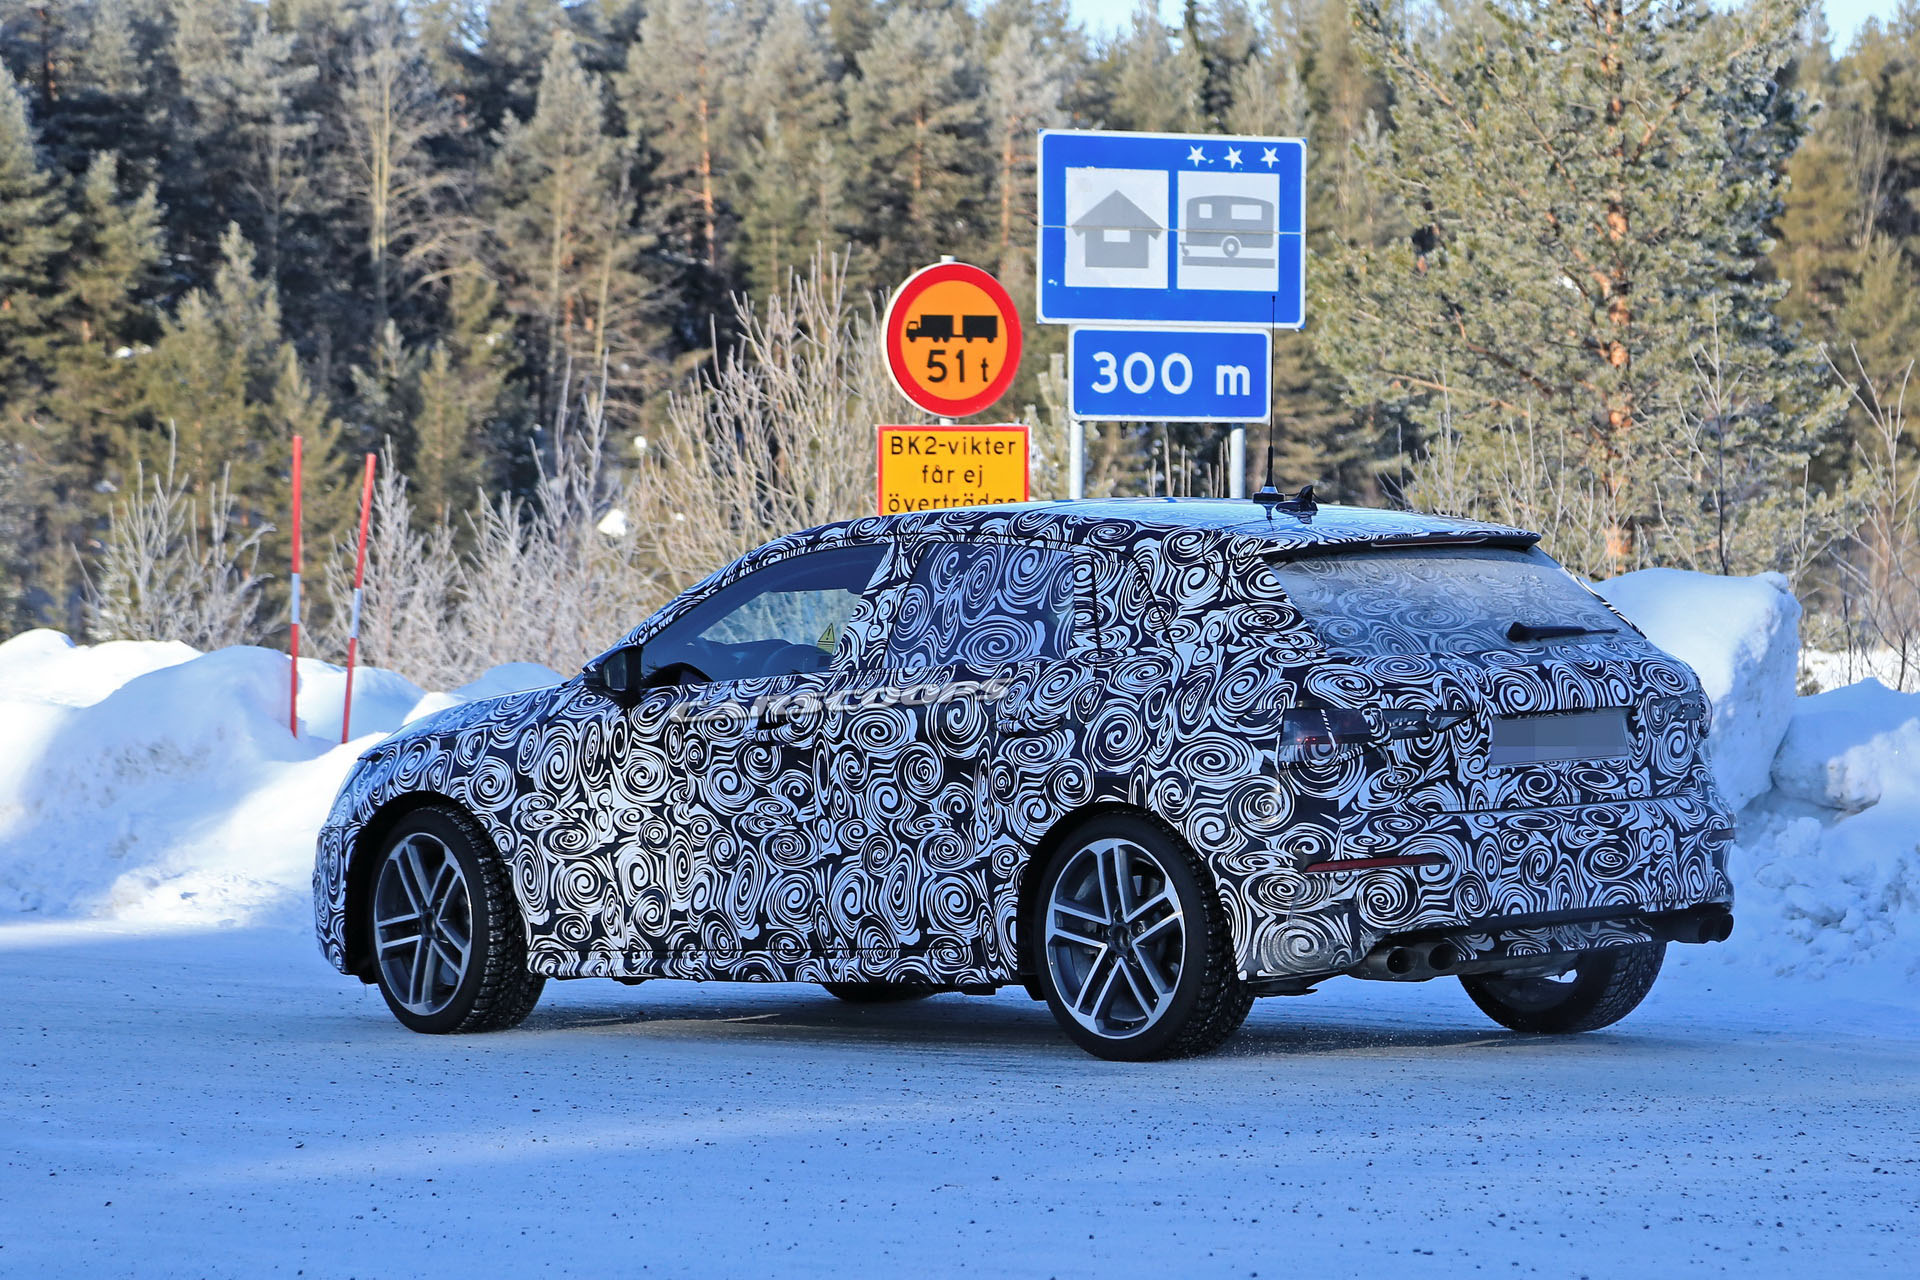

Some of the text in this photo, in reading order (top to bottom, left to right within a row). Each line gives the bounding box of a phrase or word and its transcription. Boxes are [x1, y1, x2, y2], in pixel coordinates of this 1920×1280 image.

[927, 349, 989, 383] 51 t
[1091, 351, 1251, 396] 300 m
[891, 435, 1016, 455] BK2-vikter
[922, 464, 983, 488] får ej
